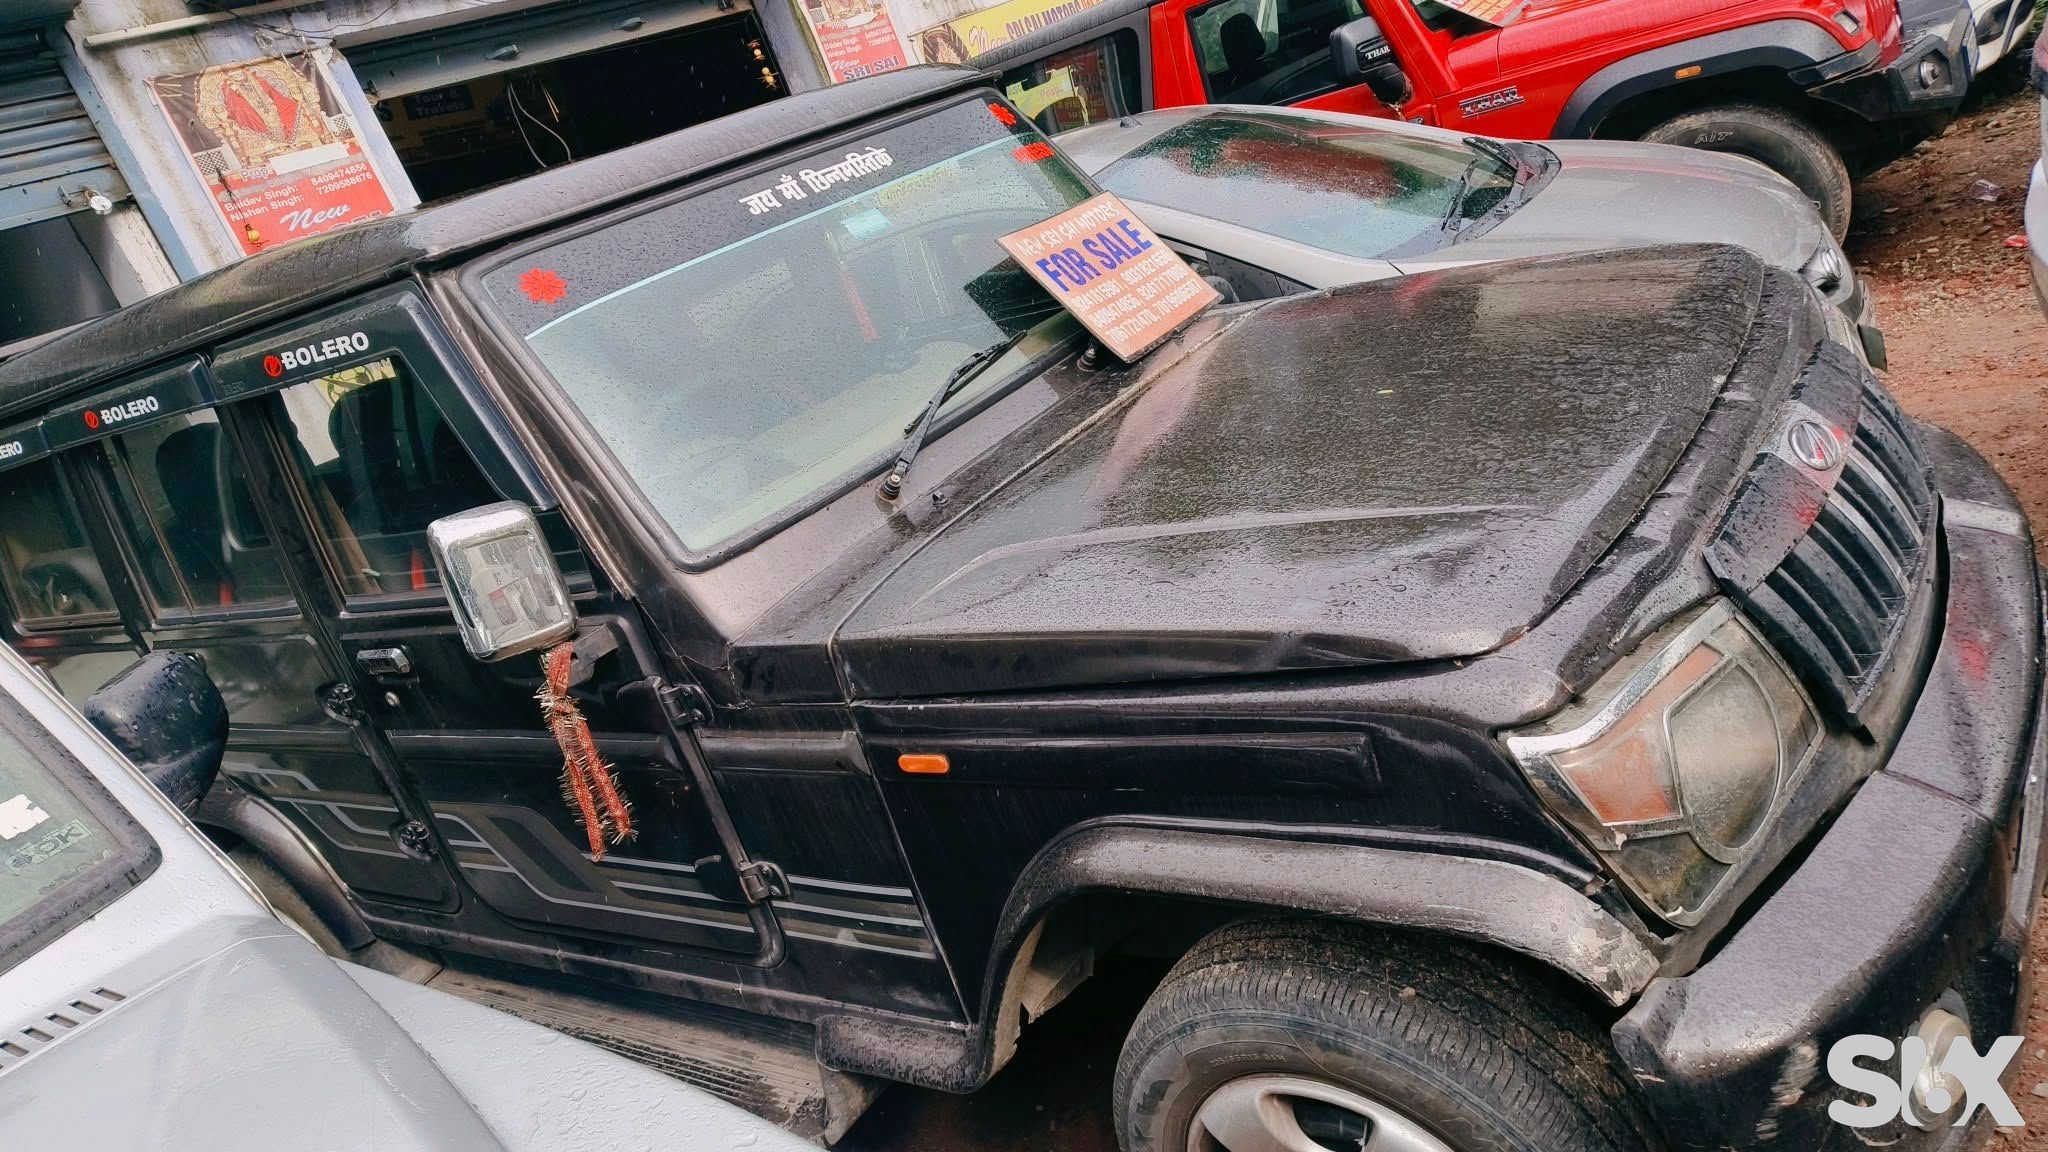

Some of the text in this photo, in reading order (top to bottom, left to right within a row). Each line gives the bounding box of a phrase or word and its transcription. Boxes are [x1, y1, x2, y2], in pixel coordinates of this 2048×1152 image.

[1365, 45, 1390, 60] THAR
[842, 55, 899, 80] SRI SAI
[739, 189, 782, 215] जय
[280, 203, 351, 232] New
[1016, 201, 1121, 257] NEW SRI SAI MOTORS
[1035, 218, 1153, 293] FOR SALE
[280, 331, 370, 371] BOLERO
[101, 396, 159, 425] BOLERO
[0, 441, 22, 459] ERO
